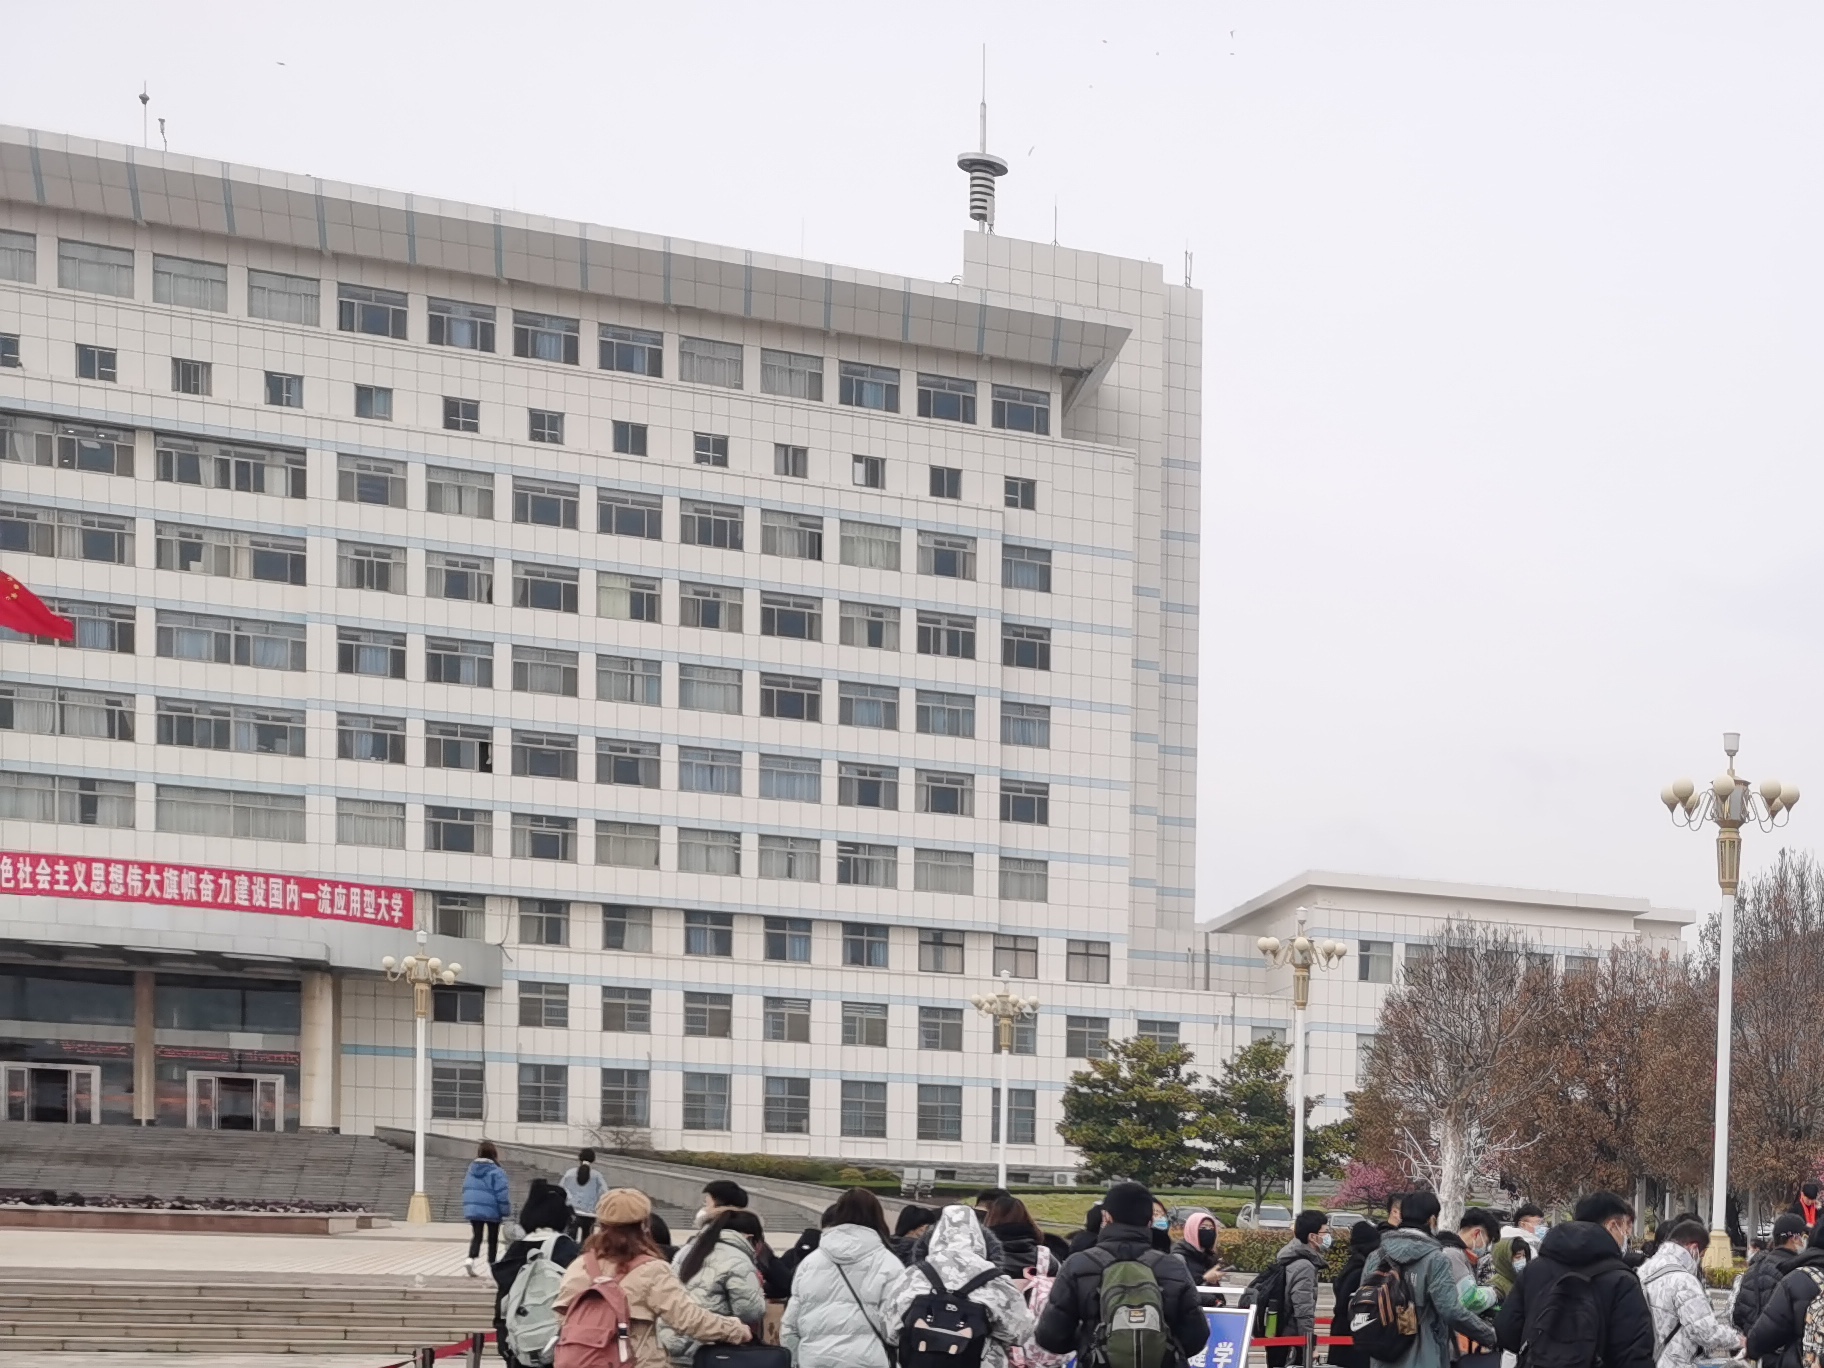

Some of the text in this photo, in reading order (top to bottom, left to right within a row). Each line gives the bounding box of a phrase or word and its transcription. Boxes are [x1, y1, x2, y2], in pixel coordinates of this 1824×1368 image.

[0, 855, 404, 924] 色社会主义思想伟大旗帜奋力建设国内一流应用型大学
